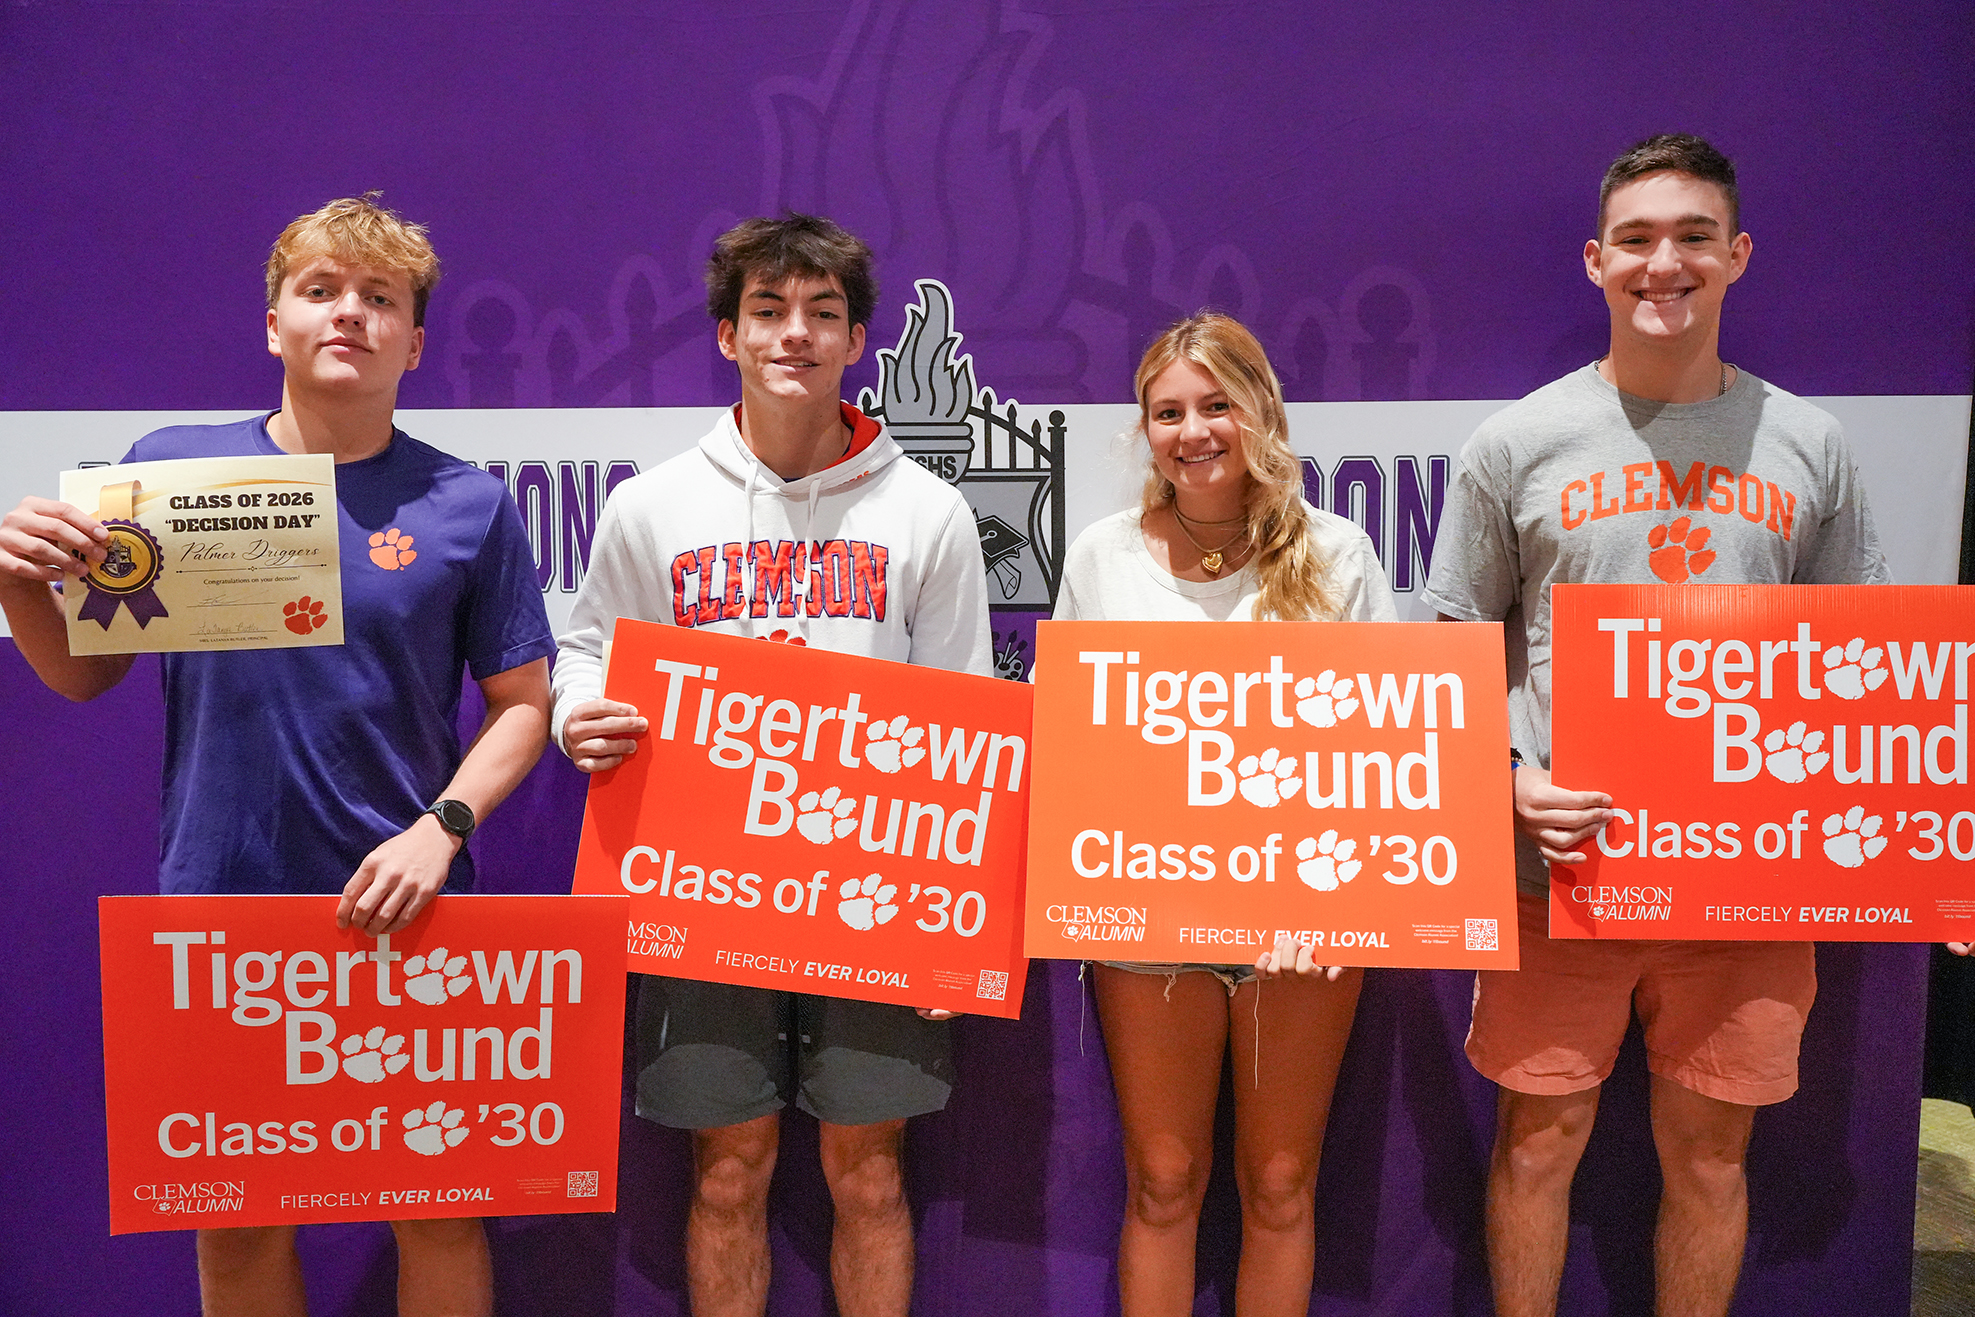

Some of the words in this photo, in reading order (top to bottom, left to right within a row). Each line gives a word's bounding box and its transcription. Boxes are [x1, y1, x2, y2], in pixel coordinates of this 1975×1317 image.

[169, 494, 232, 510] CLASS
[237, 493, 261, 507] OF
[267, 492, 314, 506] 2026
[1561, 460, 1797, 541] CLEMSON
[165, 516, 268, 532] “DECISION
[273, 514, 320, 529] DAY”
[180, 541, 238, 562] Palmer
[242, 539, 320, 566] Driggers
[670, 539, 888, 628] CLEMSON
[1596, 808, 1742, 859] Class
[1754, 810, 1808, 859] of
[1072, 830, 1216, 881] Class
[1228, 834, 1282, 882] of
[1370, 835, 1457, 885] ’30
[620, 846, 762, 908] Class
[773, 871, 829, 916] of
[908, 884, 986, 937] ’30
[1572, 886, 1672, 903] CLEMSON
[1047, 905, 1146, 924] CLEMSON
[1606, 905, 1671, 920] ALUMNI
[1706, 906, 1791, 921] FIERCELY
[1799, 907, 1849, 922] EVER
[1855, 908, 1912, 923] LOYAL
[628, 921, 688, 943] MSON
[1083, 925, 1145, 941] ALUMNI
[1180, 928, 1266, 944] FIERCELY
[1331, 932, 1389, 947] LOYAL
[716, 950, 799, 973] FIERCELY
[804, 962, 858, 982] EVER
[856, 968, 909, 988] LOYAL
[158, 1113, 318, 1158] Class
[331, 1107, 388, 1151] of
[478, 1102, 564, 1146] ’30
[134, 1181, 244, 1201] CLEMSON
[282, 1193, 371, 1208] FIERCELY
[379, 1190, 430, 1204] EVER
[436, 1188, 493, 1202] LOYAL
[173, 1198, 243, 1213] ALUMNI
